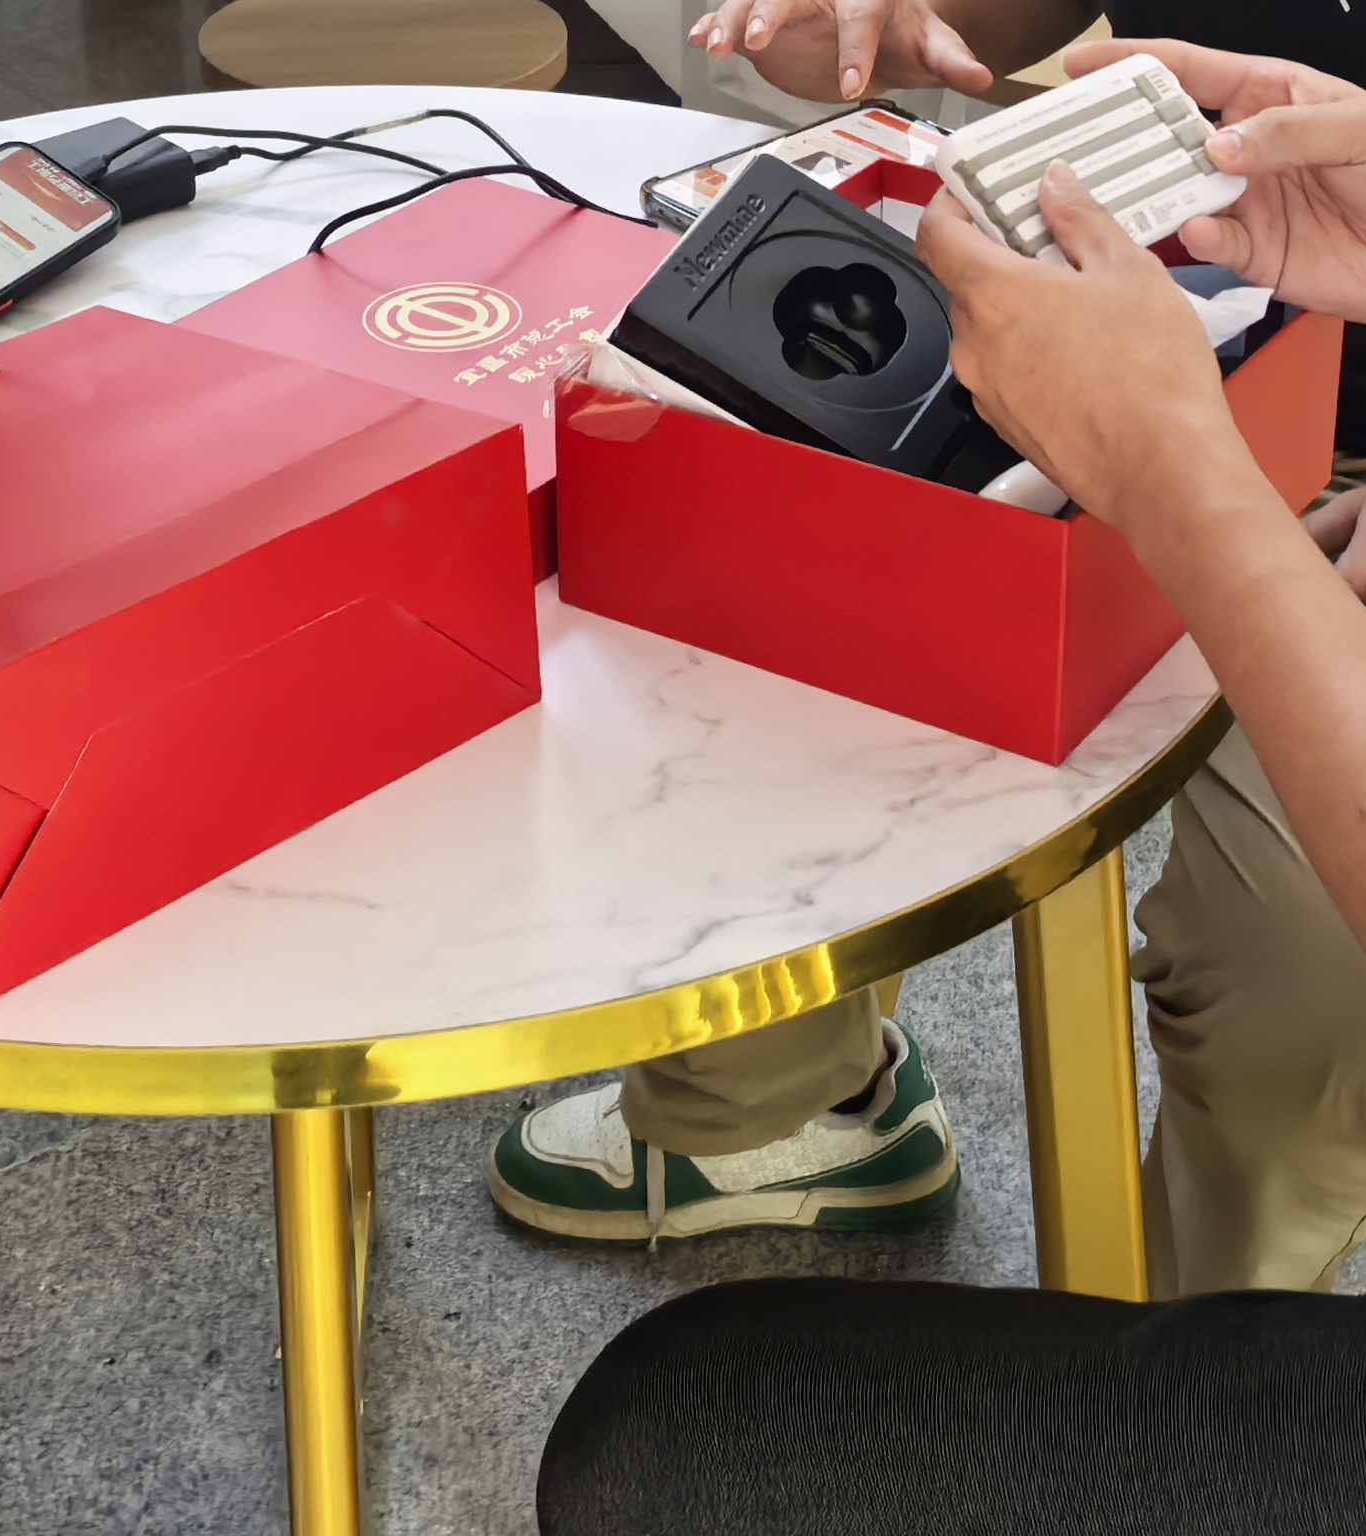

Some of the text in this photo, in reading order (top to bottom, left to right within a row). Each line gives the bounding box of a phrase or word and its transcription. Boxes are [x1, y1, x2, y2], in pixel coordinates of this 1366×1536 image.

[453, 305, 594, 387] 宜昌市总工会
